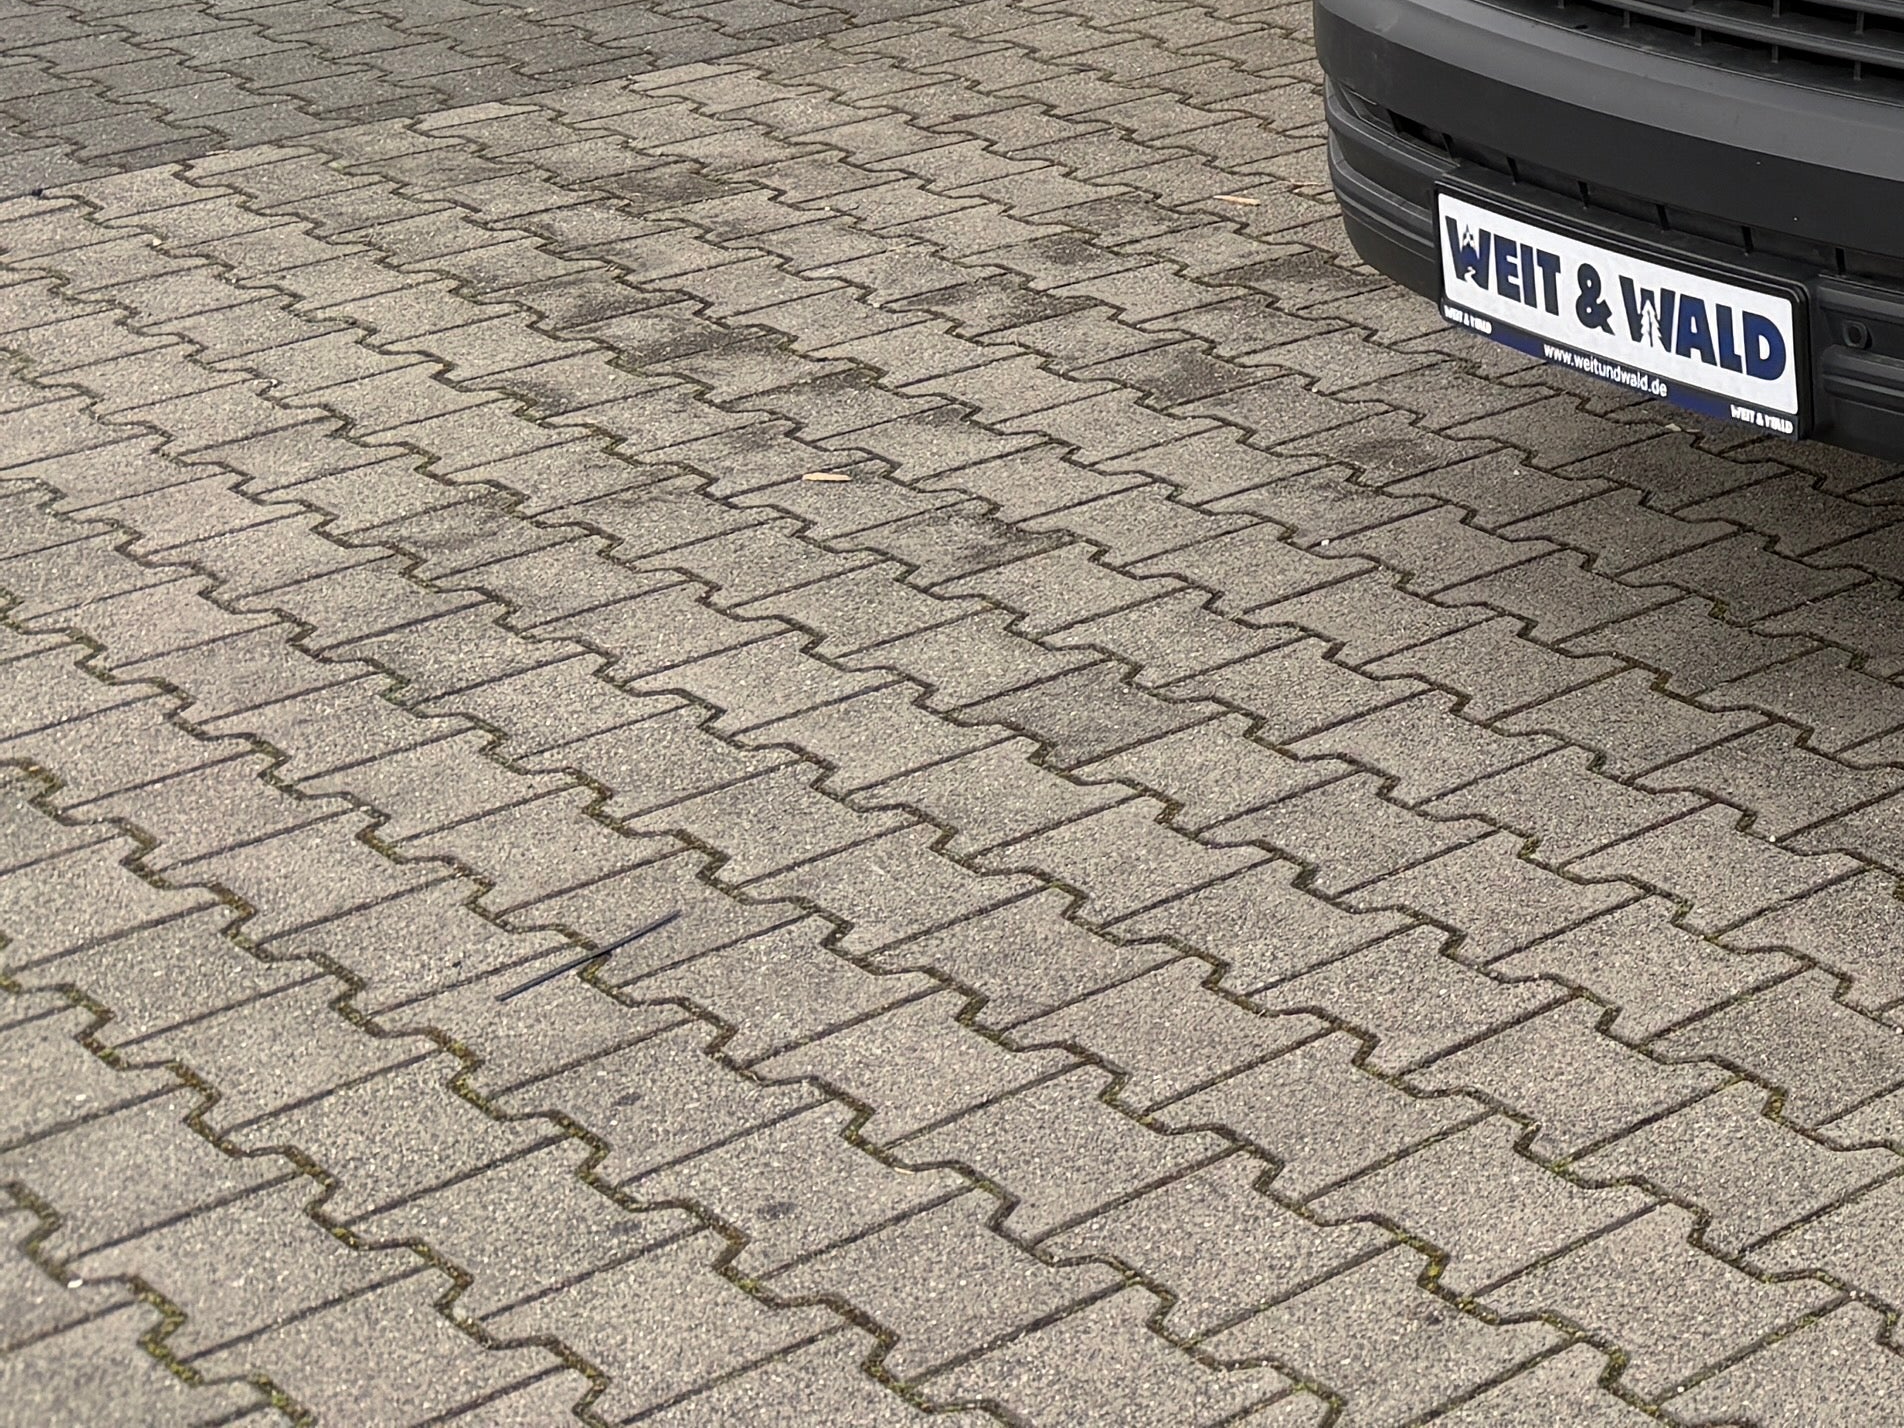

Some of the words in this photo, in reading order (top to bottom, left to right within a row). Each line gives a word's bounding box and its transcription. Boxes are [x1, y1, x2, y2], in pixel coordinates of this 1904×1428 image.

[1445, 215, 1562, 317] WEIT
[1576, 262, 1616, 336] &
[1619, 274, 1787, 382] WALD
[1543, 343, 1668, 398] www.weitundwald.de
